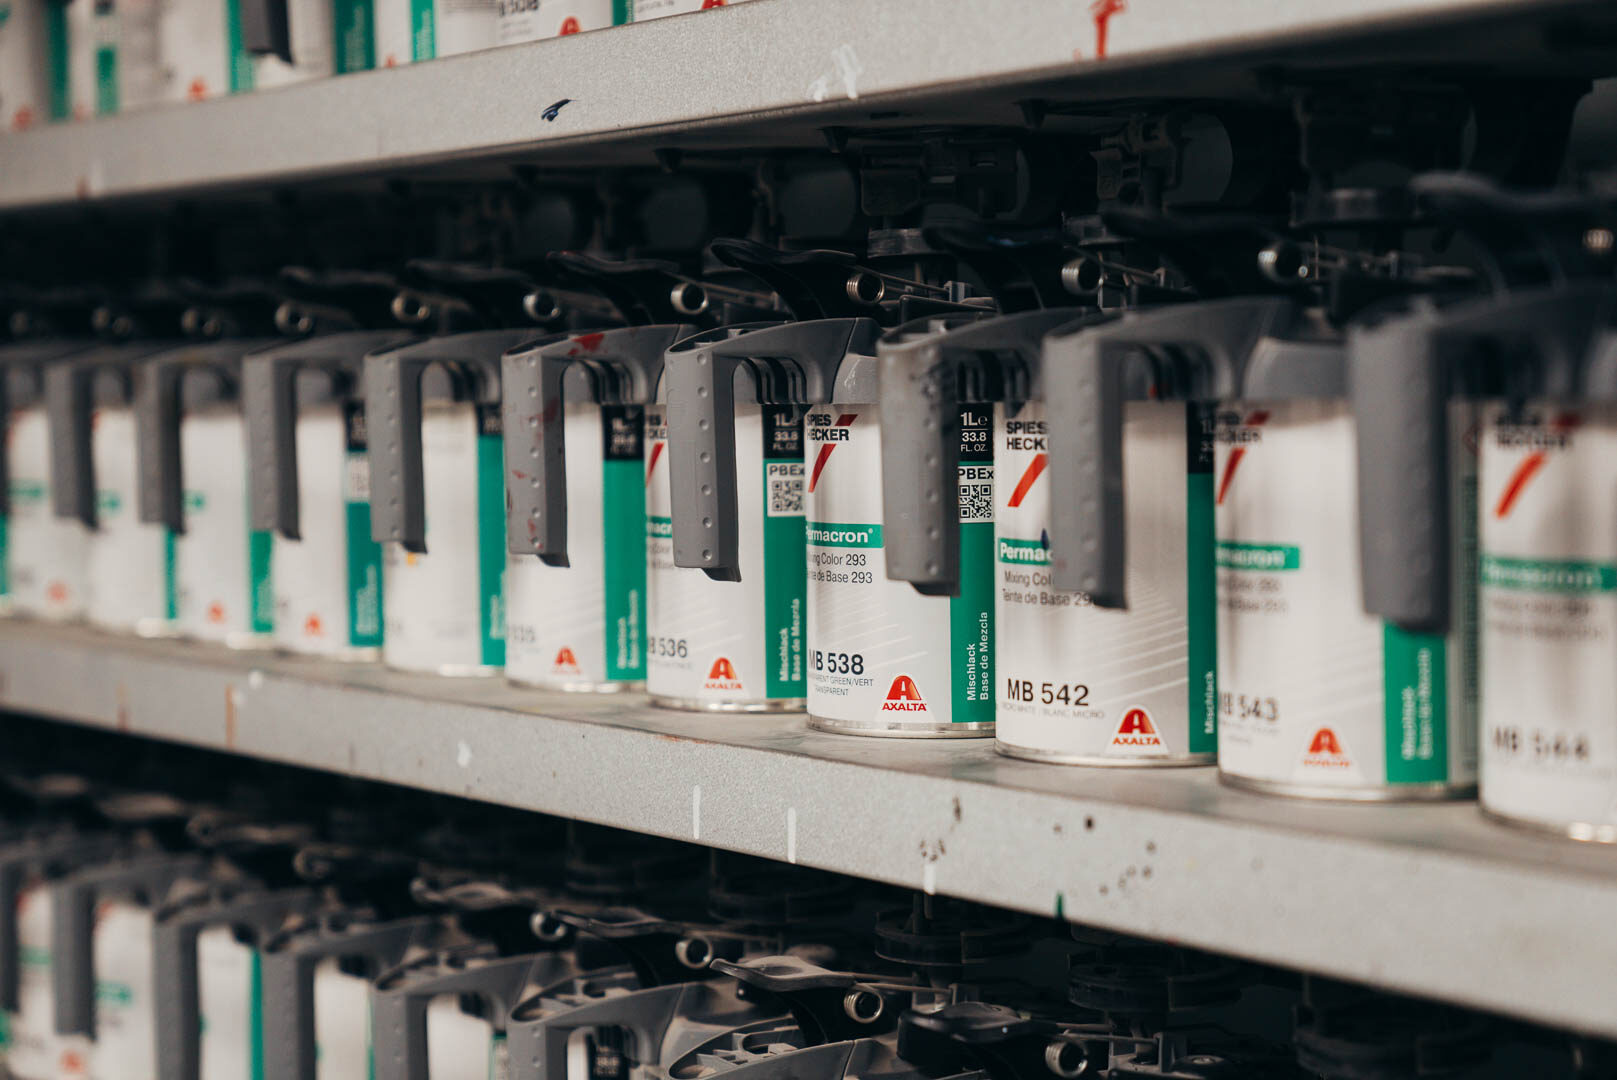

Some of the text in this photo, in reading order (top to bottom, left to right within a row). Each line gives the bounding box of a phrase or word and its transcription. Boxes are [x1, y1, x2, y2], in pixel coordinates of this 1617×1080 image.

[1006, 421, 1047, 434] SPIES
[962, 432, 987, 442] 33.8
[1006, 437, 1046, 450] HECK
[957, 468, 994, 480] PBEx
[821, 552, 843, 566] Color
[845, 553, 866, 566] 293
[826, 570, 849, 583] Base
[851, 571, 873, 584] 293
[659, 637, 687, 658] 536
[980, 612, 989, 700] Base de Mezcla
[827, 652, 864, 676] 538
[967, 643, 976, 701] Mischlack
[1007, 677, 1089, 706] MB 542
[882, 702, 927, 711] AXALTA
[1238, 694, 1279, 722] 543
[1113, 737, 1160, 745] AXALTA
